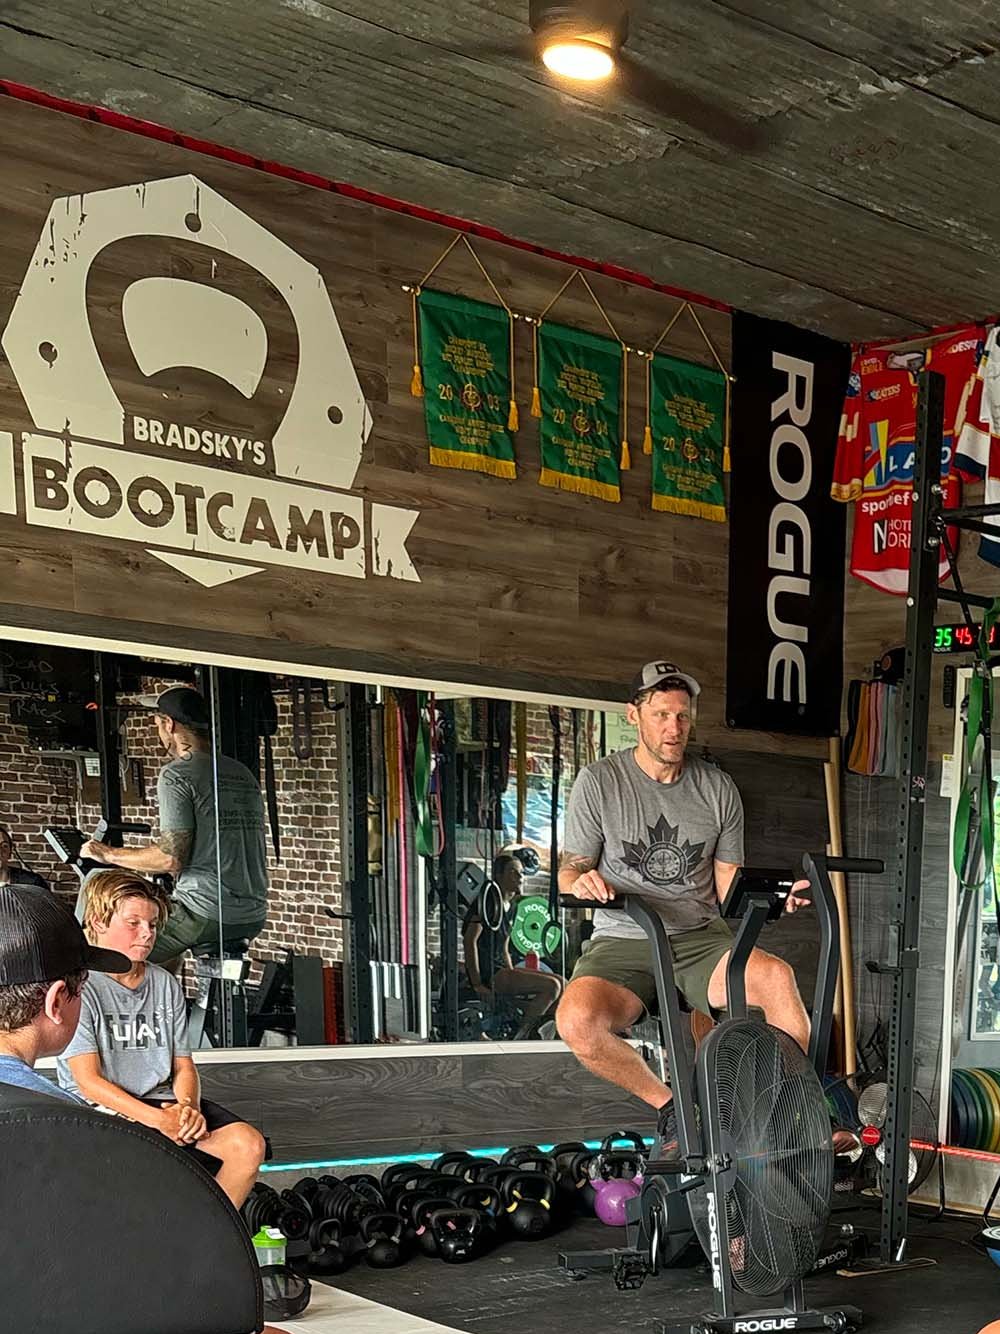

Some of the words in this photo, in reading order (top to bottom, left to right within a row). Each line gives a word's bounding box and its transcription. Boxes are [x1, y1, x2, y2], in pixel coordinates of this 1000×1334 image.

[438, 384, 453, 401] 20
[133, 415, 267, 466] BRADSKY'S
[31, 454, 362, 562] BOOTCAMP
[767, 351, 814, 704] ROGUE
[934, 627, 953, 647] 35
[735, 1318, 798, 1333] ROGUE
